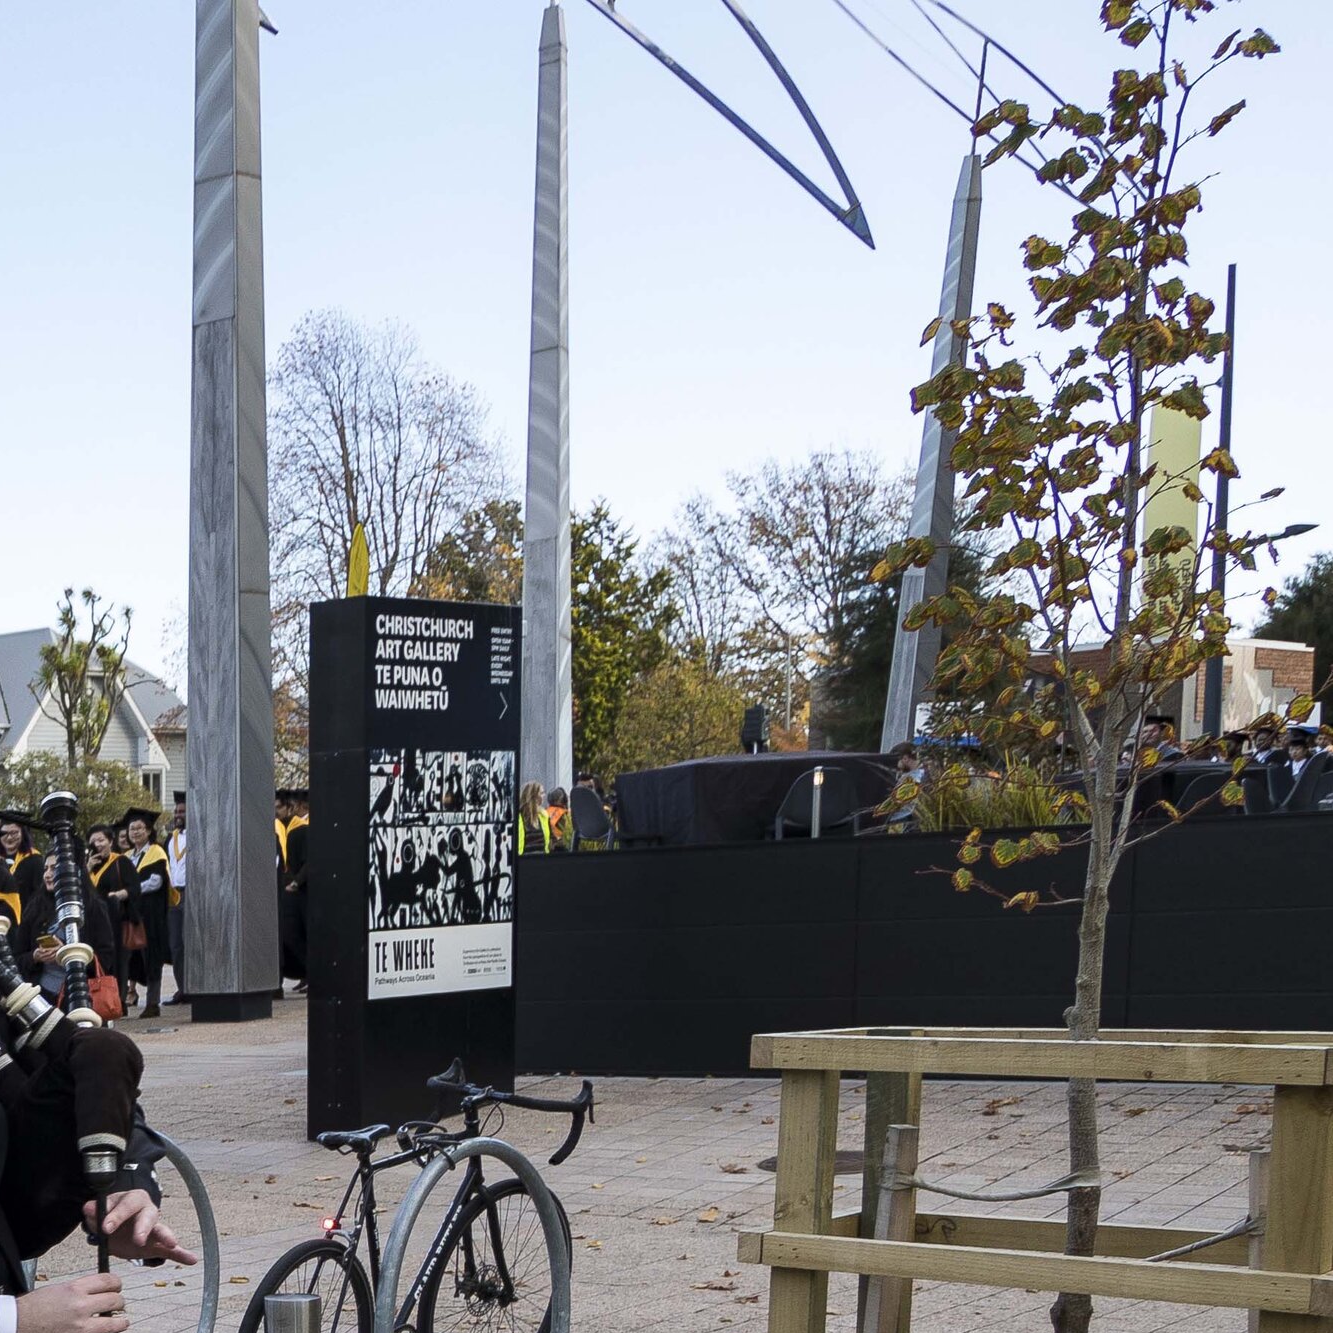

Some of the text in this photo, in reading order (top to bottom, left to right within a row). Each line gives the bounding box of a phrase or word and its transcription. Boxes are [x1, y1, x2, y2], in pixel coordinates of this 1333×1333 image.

[376, 614, 474, 639] CHRISTCHURCH
[375, 638, 460, 662] ART GALLERY
[375, 664, 442, 687] TE PUNA O
[375, 685, 449, 710] WAIWHETŪ
[375, 942, 387, 973] TE
[393, 938, 434, 972] WHEKE
[375, 977, 398, 986] Pathways
[399, 975, 415, 983] Across
